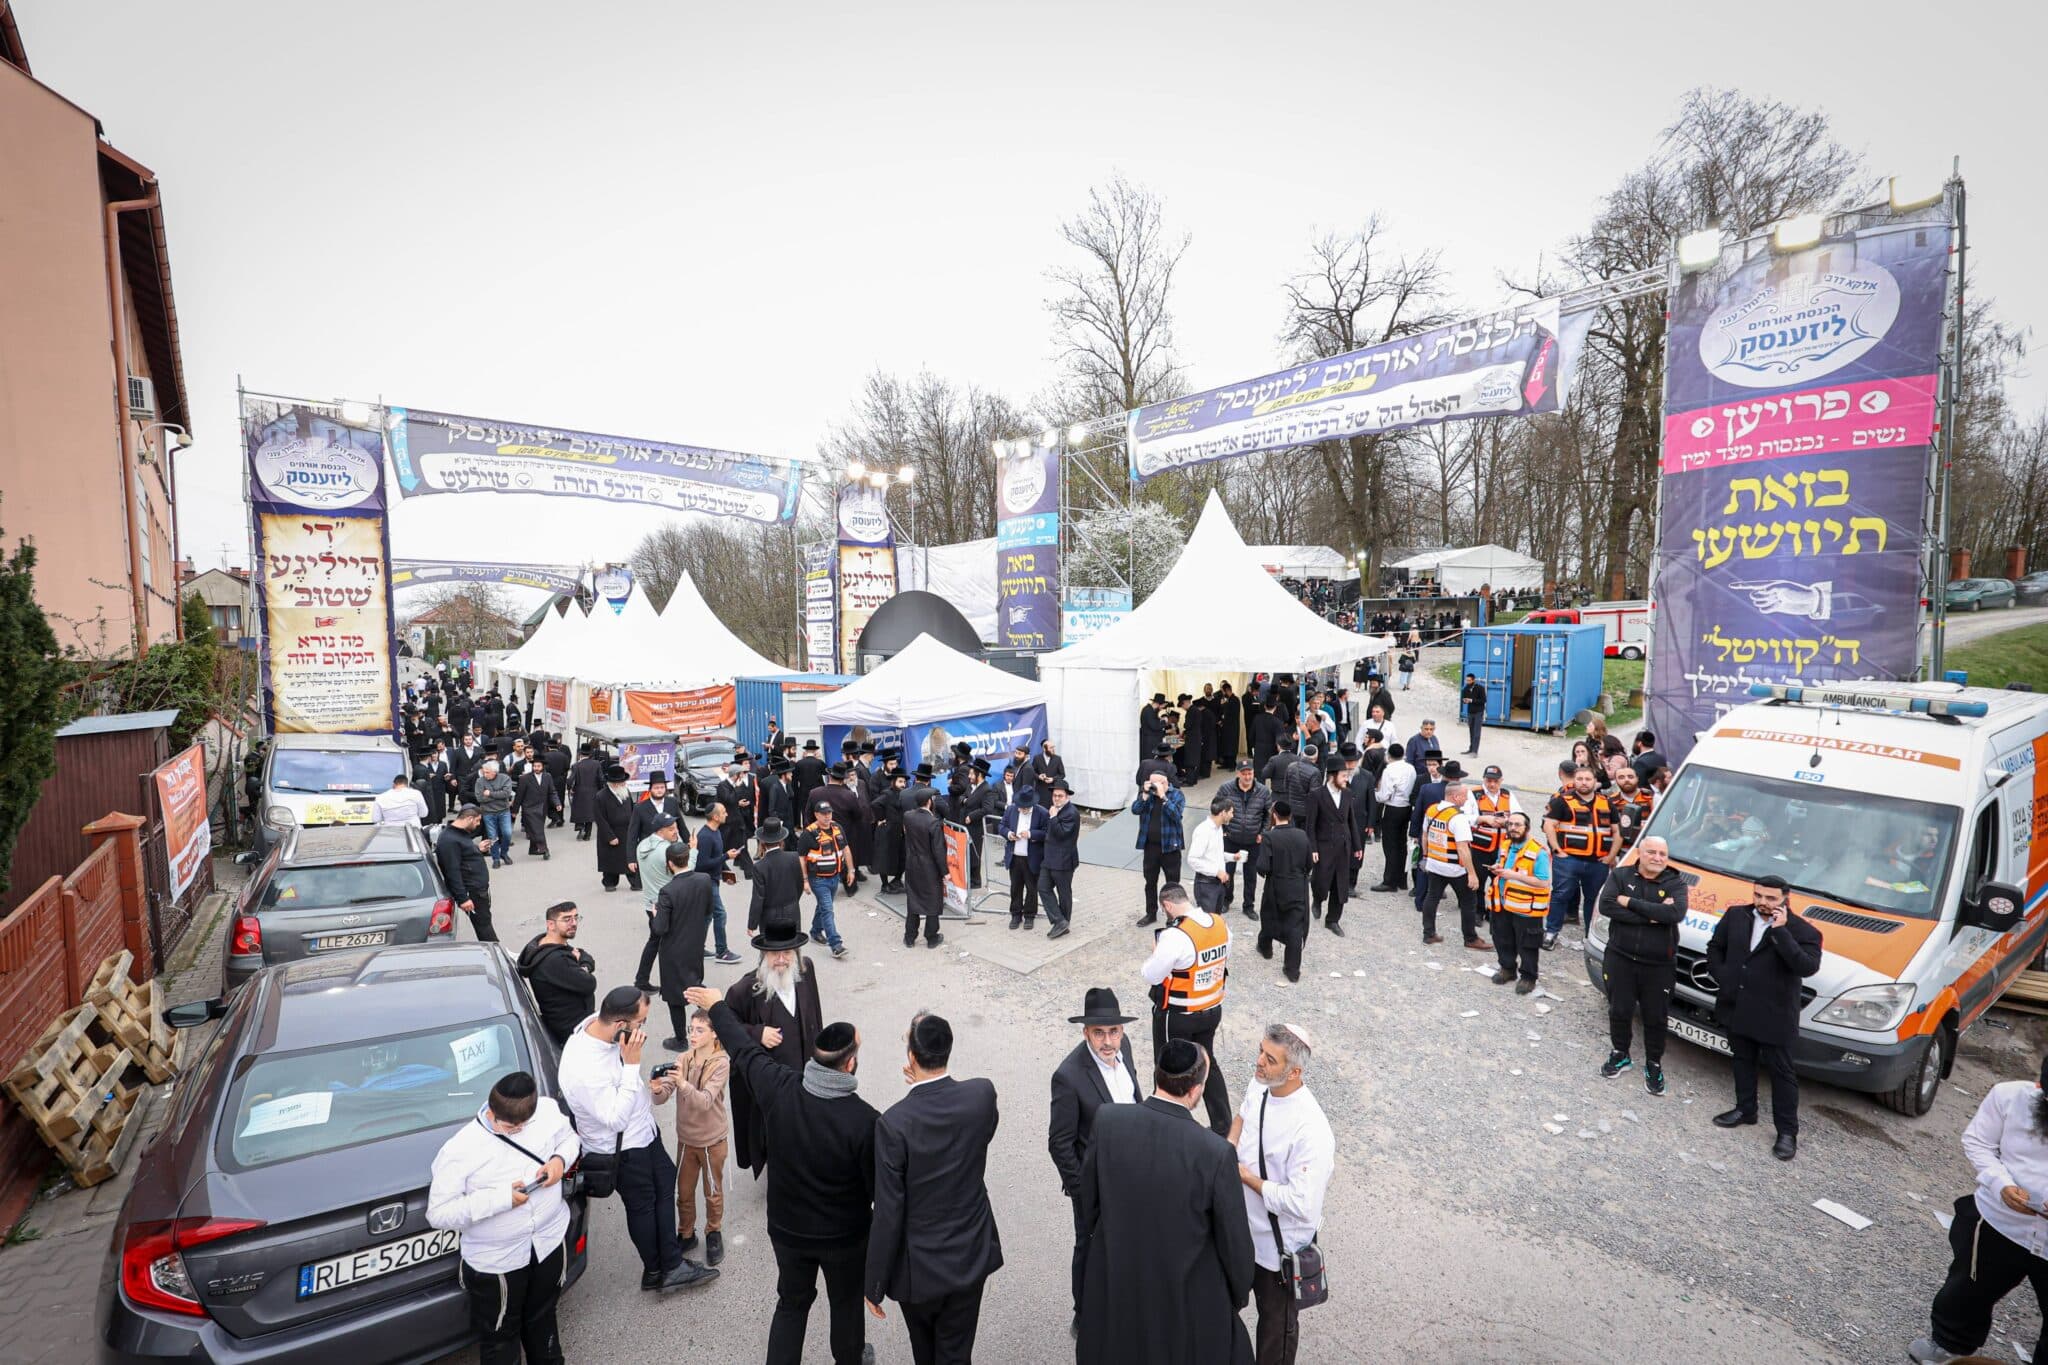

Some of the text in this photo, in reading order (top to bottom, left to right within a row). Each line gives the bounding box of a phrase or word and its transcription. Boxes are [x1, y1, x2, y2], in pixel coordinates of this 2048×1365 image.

[1748, 303, 1841, 331] הכנסת אורחים
[1427, 313, 1539, 363] הכנסת
[1740, 314, 1847, 361] ליזענסק
[1321, 342, 1424, 388] אורחים
[1408, 393, 1461, 418] האהל
[1722, 390, 1850, 443] פרויען
[1345, 410, 1370, 429] של
[1757, 435, 1824, 457] נכנסות
[1852, 426, 1906, 446] נשים
[569, 438, 653, 462] אורחים
[656, 447, 727, 472] הכנסת
[1681, 451, 1711, 472] ימין
[1715, 444, 1753, 461] מצד
[289, 461, 348, 471] הכנסת אורחים
[286, 470, 352, 486] ליזענסק
[440, 467, 509, 491] טוילעט
[553, 475, 643, 499] היכל תורה
[677, 491, 749, 513] שטיבלעך
[1723, 469, 1850, 515] בזאת
[1692, 516, 1888, 570] תיוושעו
[270, 551, 379, 580] הייליגע
[298, 635, 364, 649] מה נורא
[287, 652, 375, 669] המקום הזה
[1741, 729, 1923, 761] UNITED HATZALAH
[319, 933, 384, 949] LLE 26373
[1201, 945, 1227, 963] חובש
[1686, 1026, 1716, 1046] 0131
[459, 1040, 486, 1062] TAXI
[315, 1230, 457, 1292] RLE 52062
[208, 1271, 264, 1288] CIVIC
